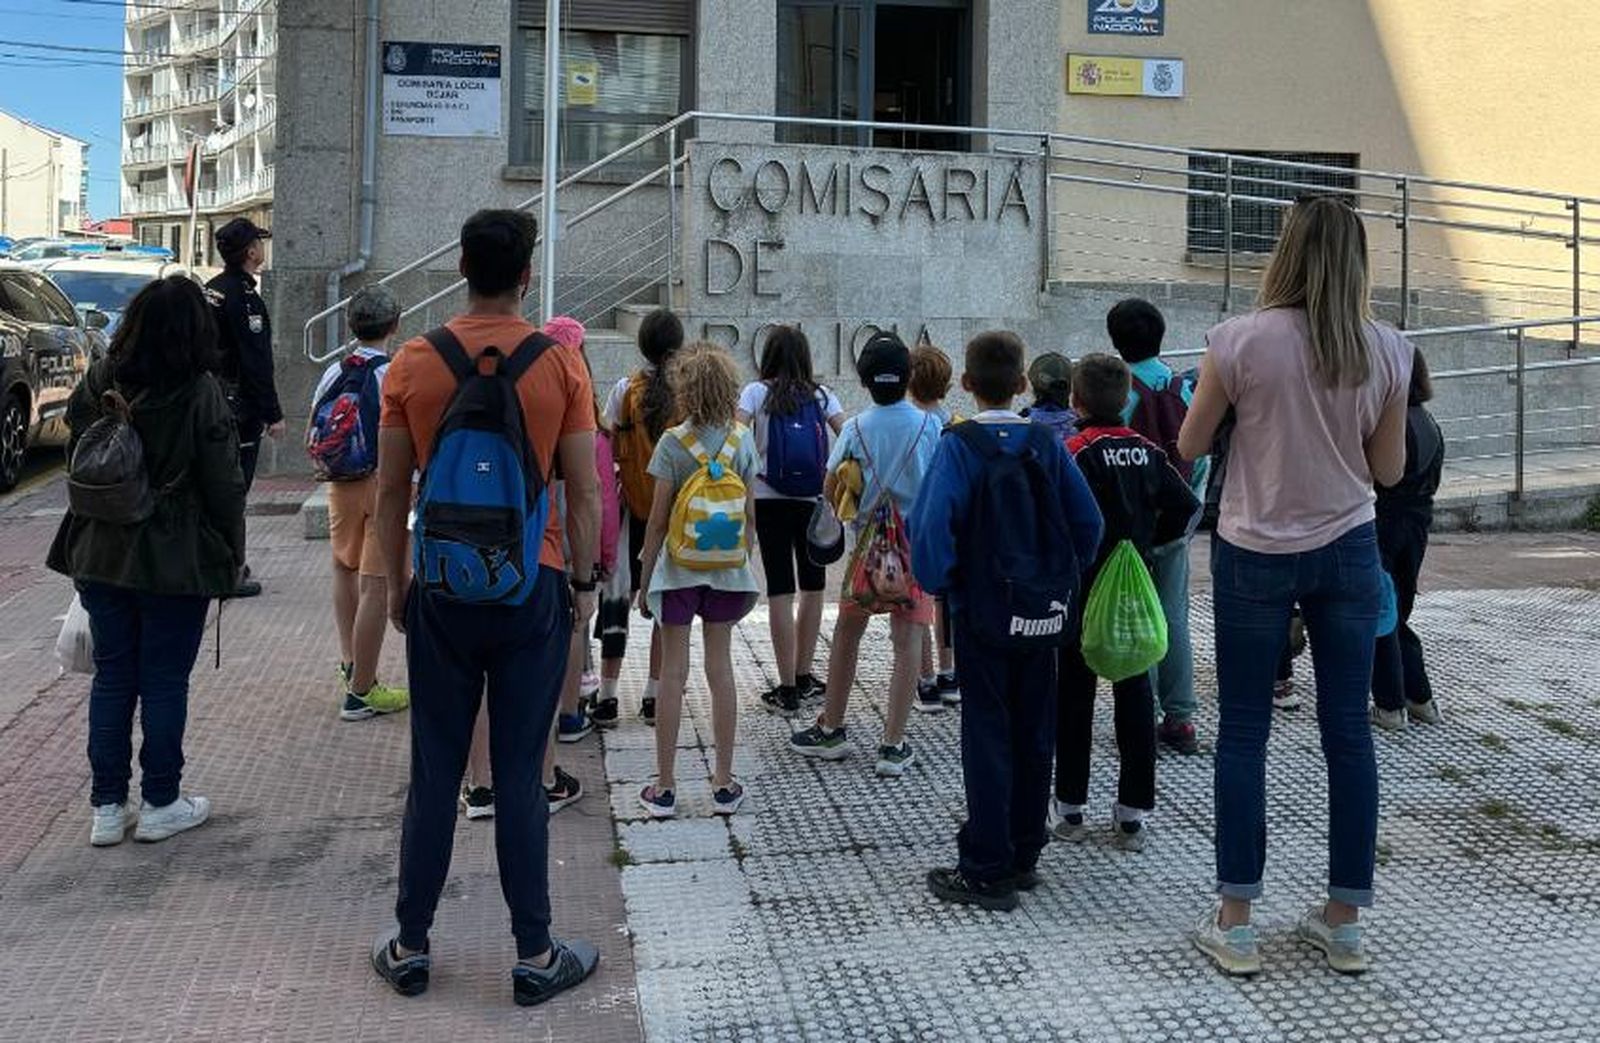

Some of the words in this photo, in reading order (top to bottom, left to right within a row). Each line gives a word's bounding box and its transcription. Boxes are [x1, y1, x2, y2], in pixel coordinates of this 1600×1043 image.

[1093, 23, 1159, 33] NACIONAL
[708, 157, 1031, 226] COMISARIA
[706, 239, 784, 297] DE
[703, 321, 933, 377] POIC
